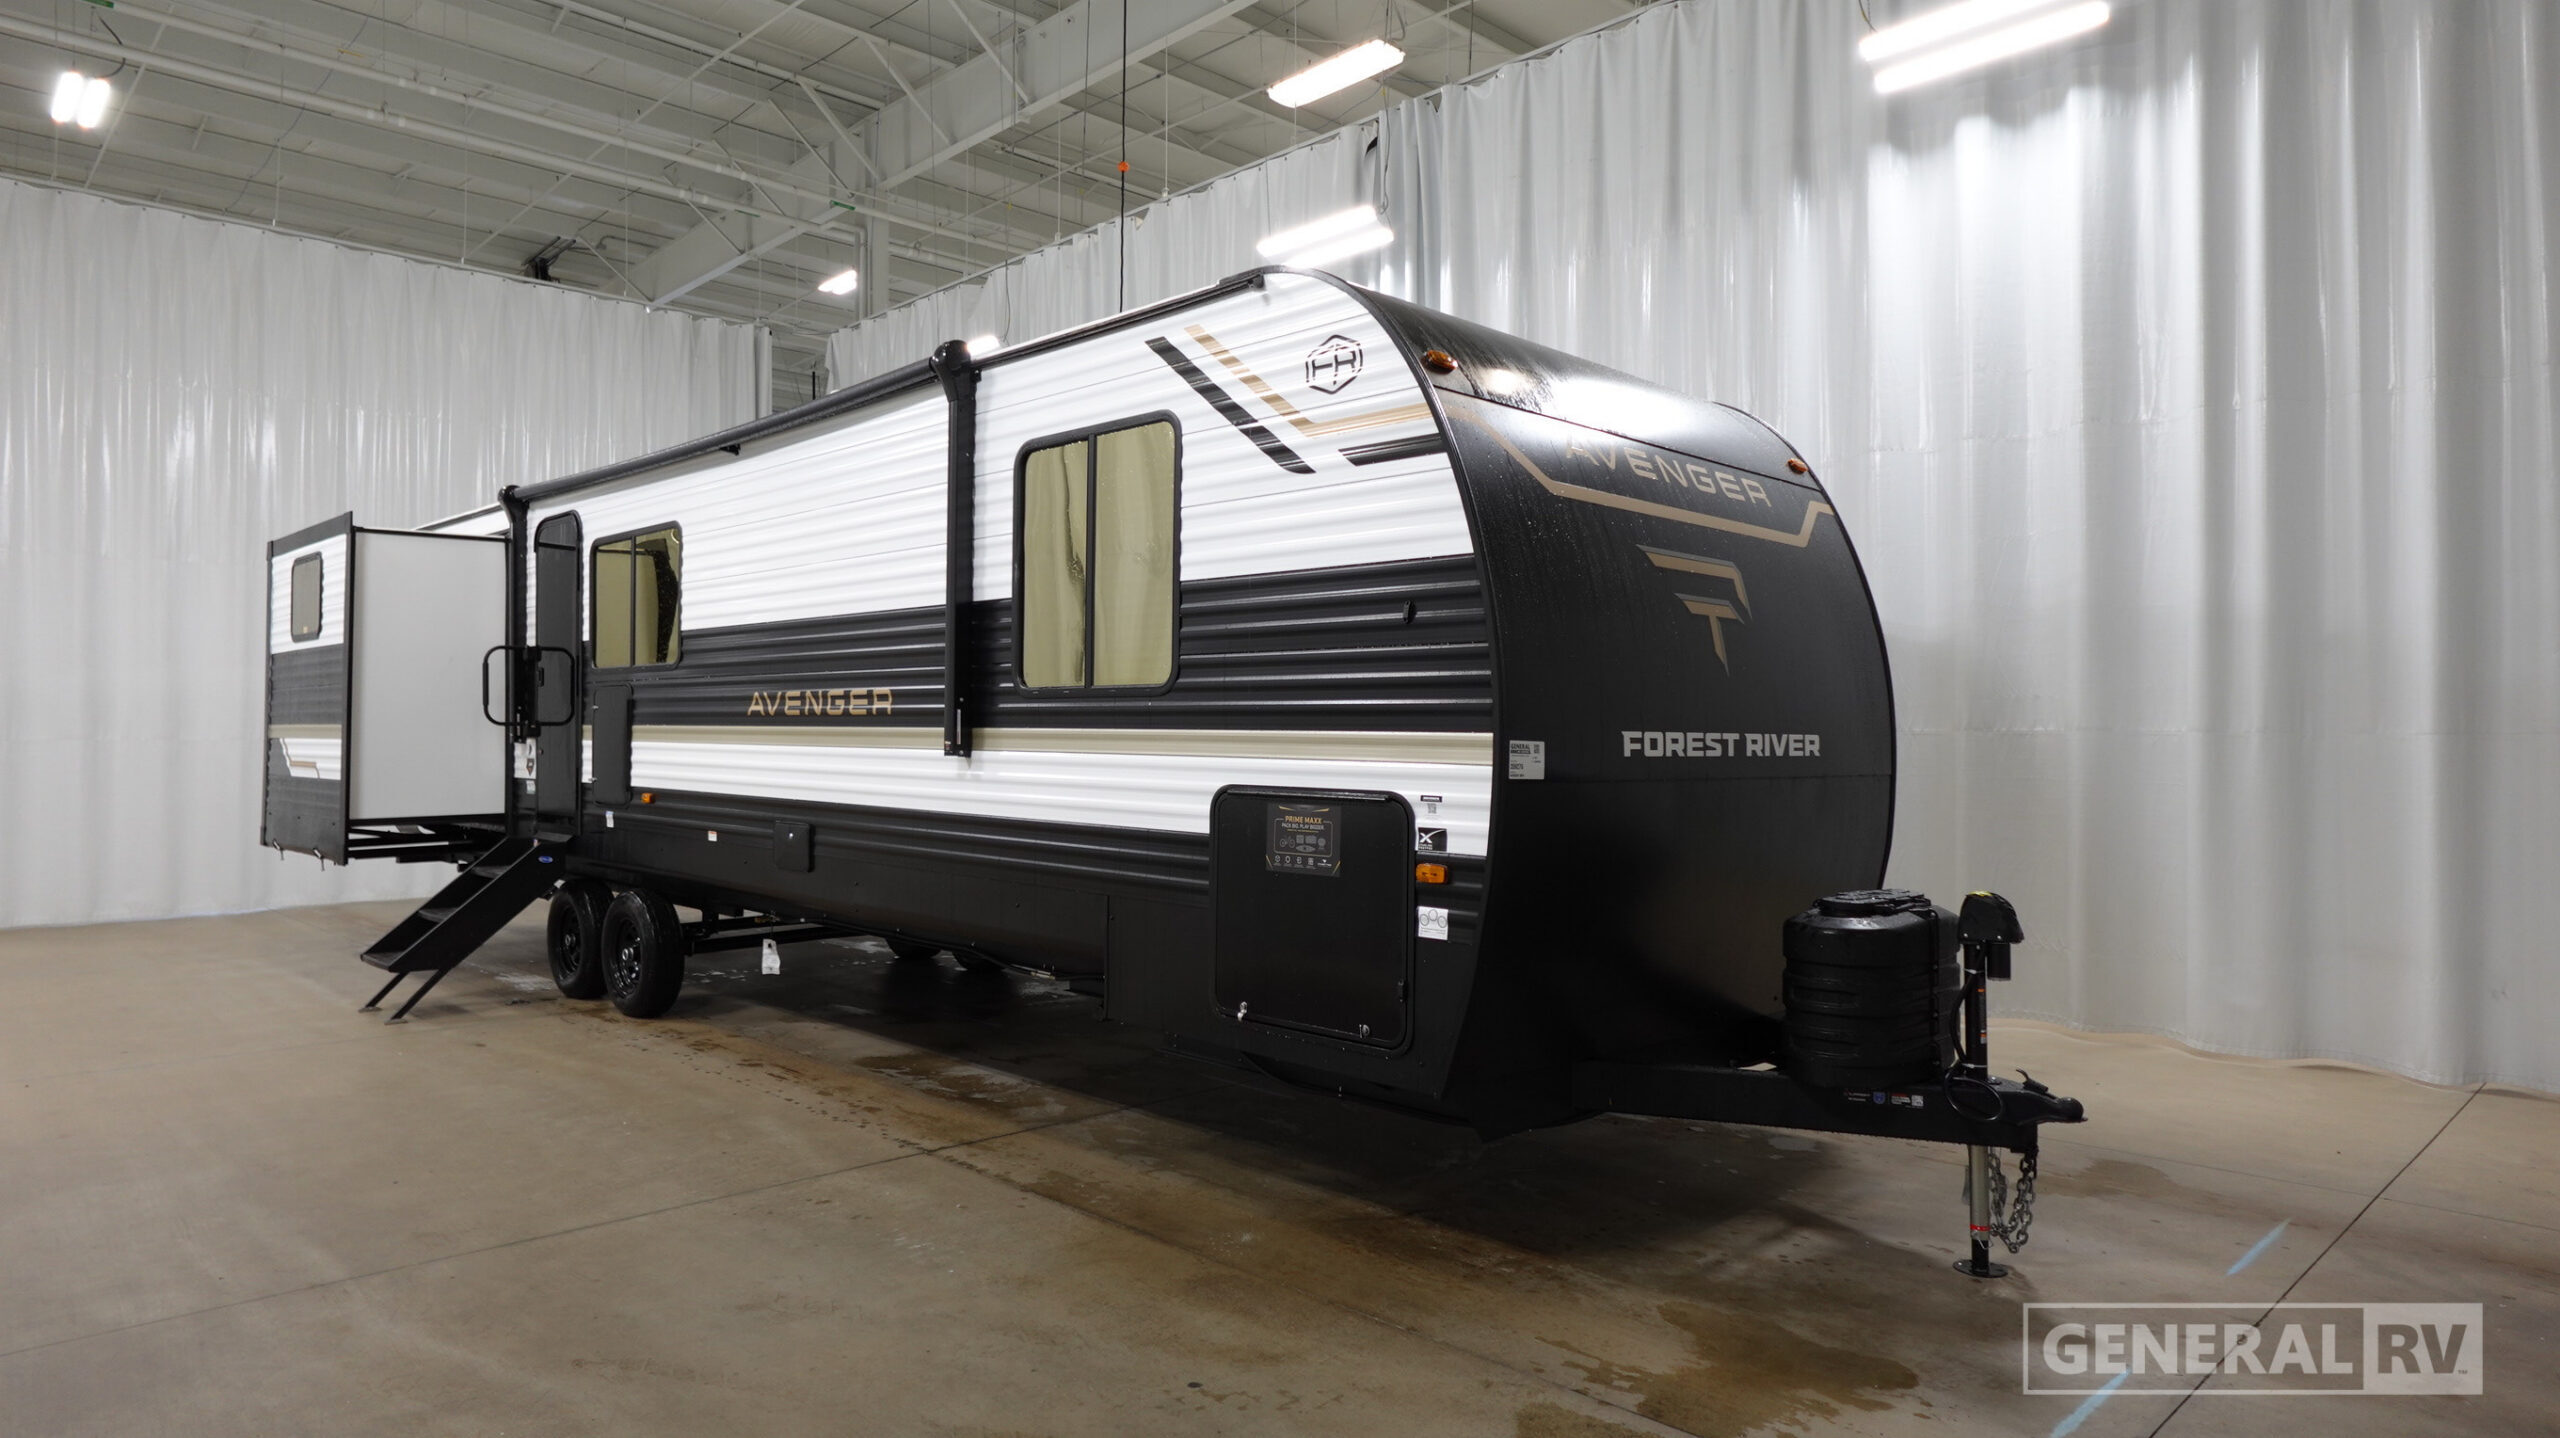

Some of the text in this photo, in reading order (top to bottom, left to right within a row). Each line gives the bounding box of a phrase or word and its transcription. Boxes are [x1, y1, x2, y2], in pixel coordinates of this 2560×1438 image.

[1566, 437, 1772, 508] AVENGER
[747, 688, 893, 716] AVENGER
[1621, 731, 1821, 757] FOREST RIVER
